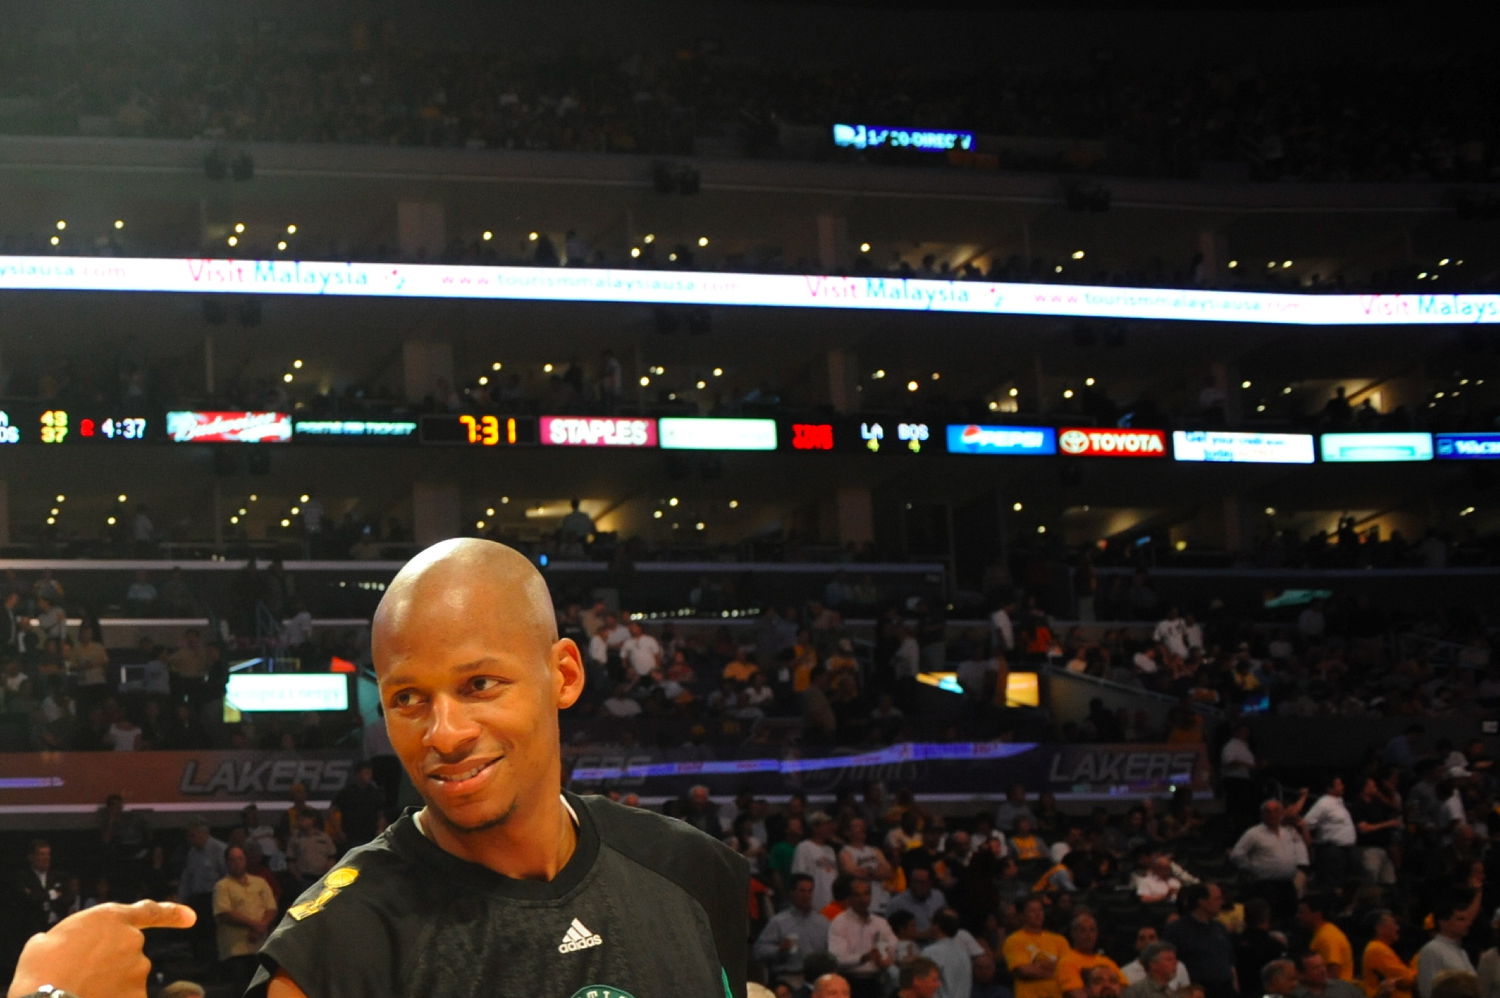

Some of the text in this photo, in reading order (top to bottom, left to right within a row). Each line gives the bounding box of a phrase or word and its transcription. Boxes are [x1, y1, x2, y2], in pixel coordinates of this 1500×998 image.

[185, 259, 244, 283] Visit
[253, 261, 369, 294] Malaysia
[804, 276, 857, 299] Visit
[865, 278, 970, 310] Malaysia
[1359, 295, 1409, 316] Visit
[40, 410, 68, 427] 43
[101, 417, 146, 439] 4:37
[40, 426, 68, 443] 37
[458, 415, 516, 445] 7:31
[549, 418, 648, 445] STAPLES
[860, 422, 929, 441] LA BOS
[1089, 432, 1164, 453] TOYOTA
[180, 759, 354, 793] LAKERS
[1050, 752, 1196, 783] LAKERS
[558, 934, 603, 954] adidas
